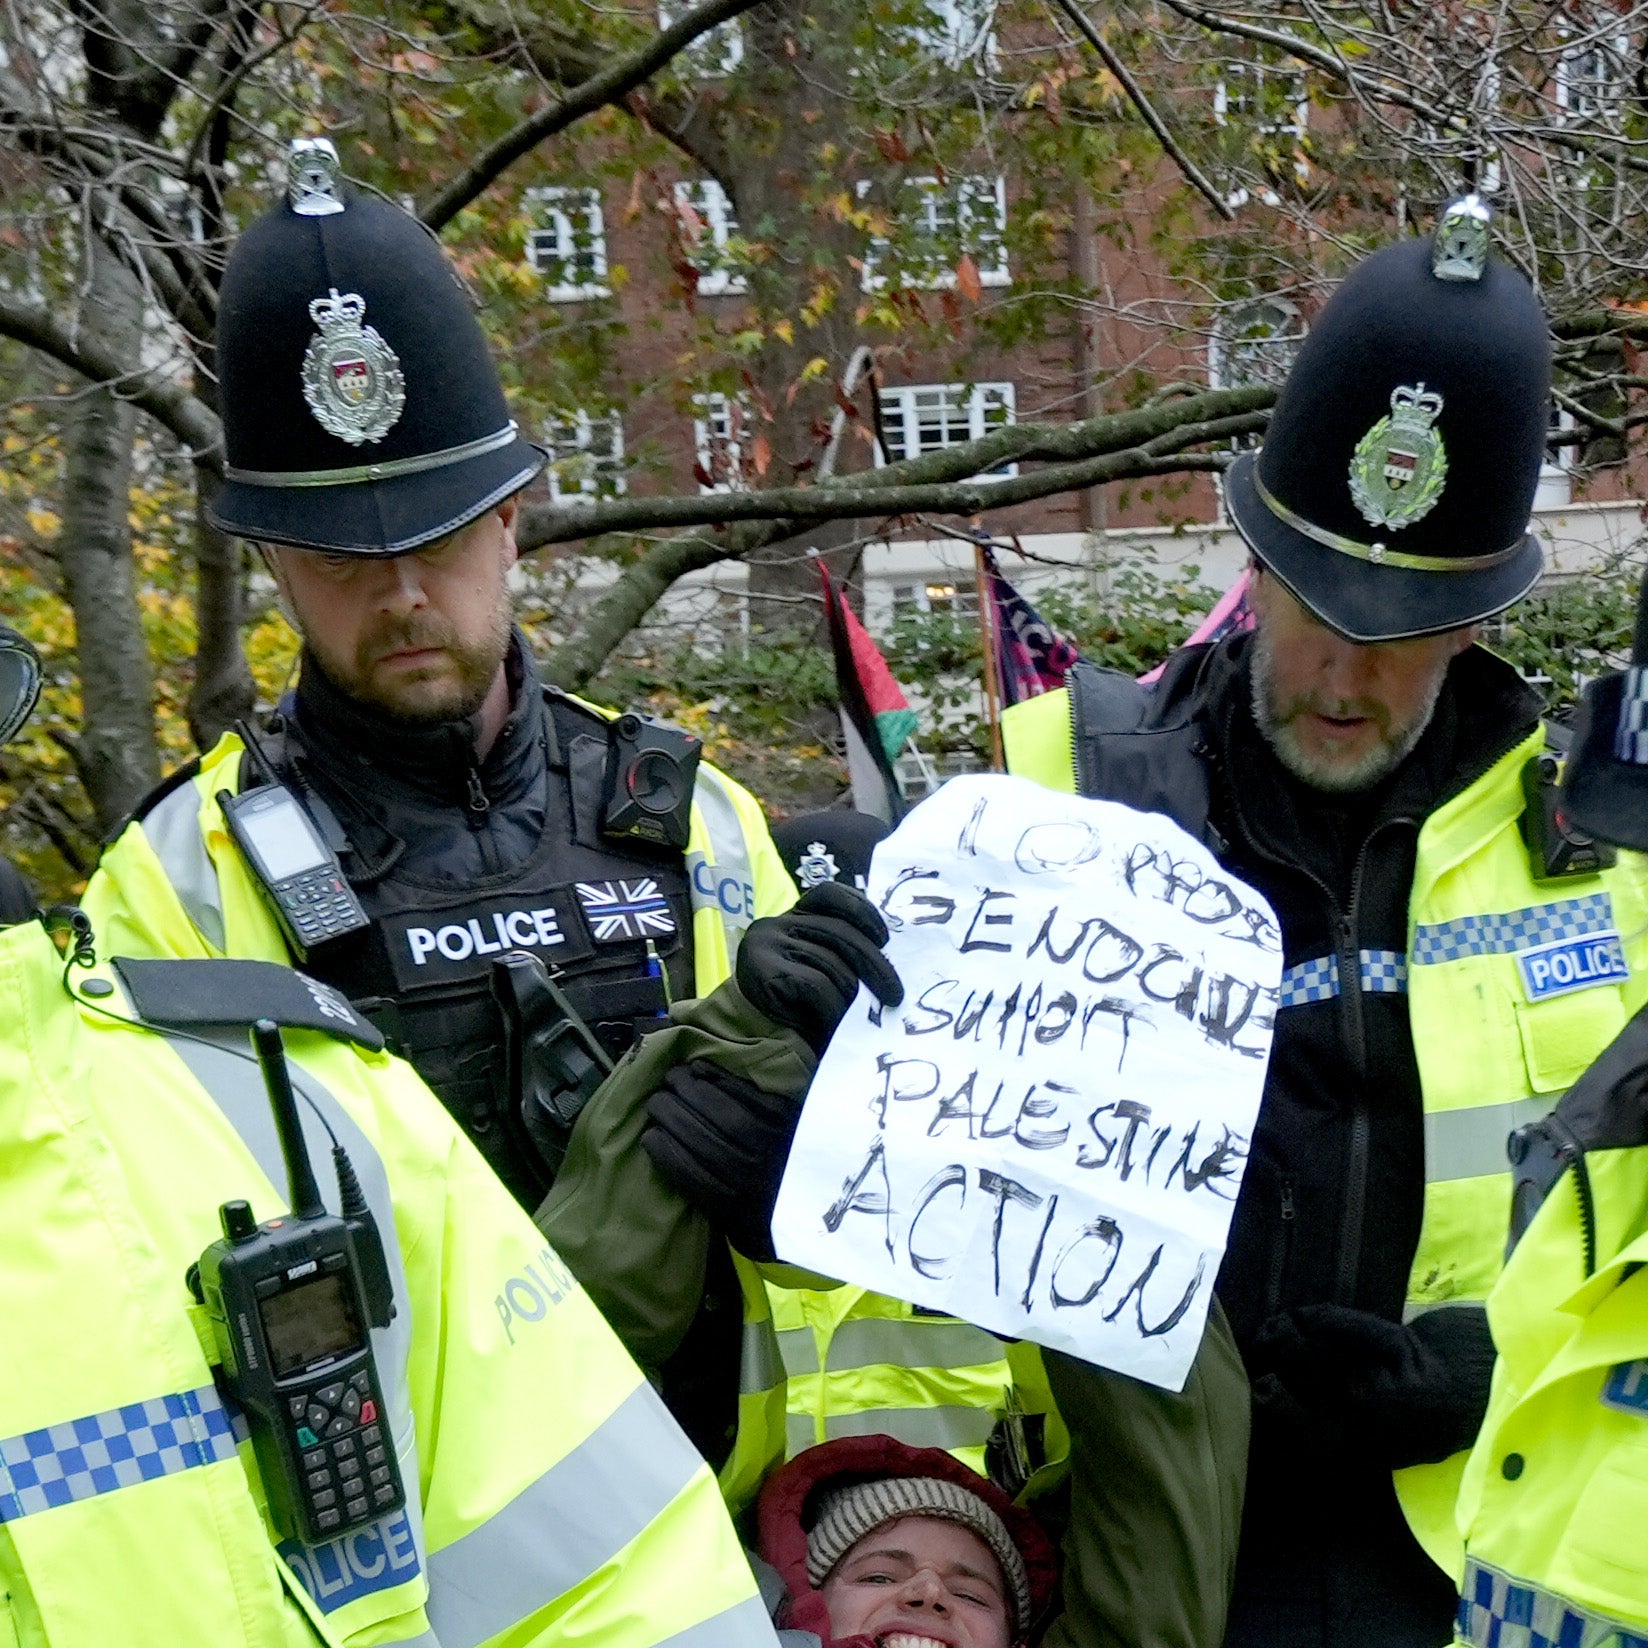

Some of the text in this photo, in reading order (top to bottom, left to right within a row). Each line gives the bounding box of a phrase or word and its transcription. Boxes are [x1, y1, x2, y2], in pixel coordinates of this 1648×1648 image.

[405, 906, 566, 966] POLICE
[880, 865, 1283, 1060] GENOCIDE
[1530, 941, 1626, 990] POLICE
[869, 1051, 1251, 1203] PALESTINE
[823, 1134, 1208, 1340] ACTION
[285, 1510, 416, 1601] OLICE
